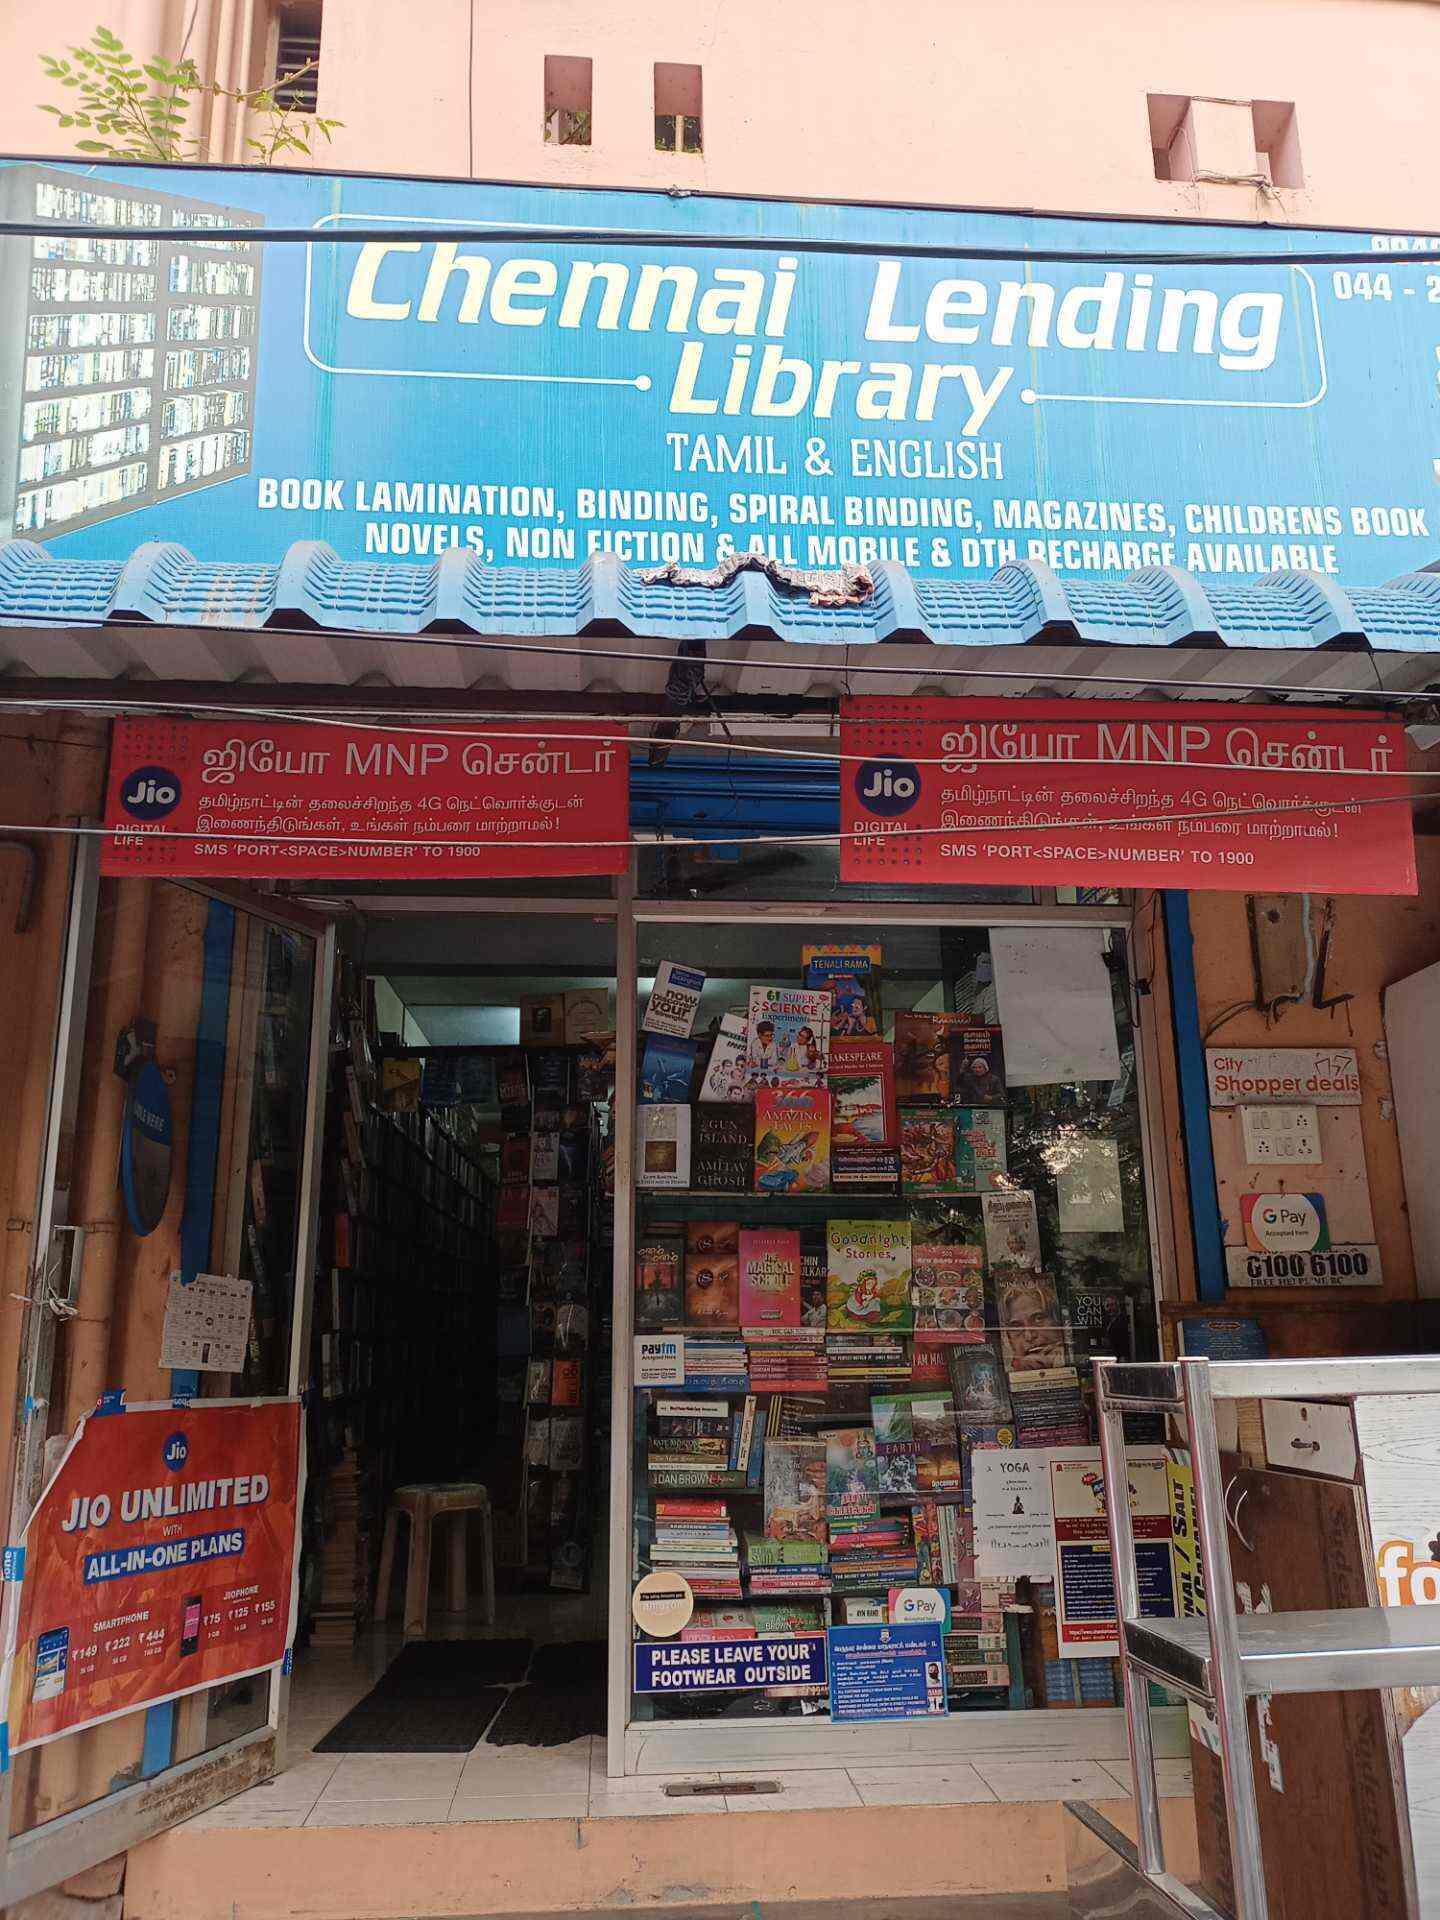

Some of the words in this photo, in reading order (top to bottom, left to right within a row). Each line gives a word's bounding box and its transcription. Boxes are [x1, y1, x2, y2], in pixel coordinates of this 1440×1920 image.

[1333, 271, 1392, 301] 044
[346, 241, 798, 337] Chennai
[864, 260, 1284, 371] Lending
[668, 341, 1014, 436] Library
[666, 433, 787, 474] TAMIL
[804, 437, 834, 476] &
[851, 438, 1003, 480] ENGLISH
[258, 478, 344, 511] BOOK
[355, 480, 565, 523] LAMINATION,
[577, 488, 719, 529] BINDING,
[729, 492, 835, 526] SPIRAL
[844, 496, 983, 533] BINDING,
[993, 498, 1176, 538] MAGAZINES,
[1184, 503, 1342, 535] CHILDRENS
[1350, 506, 1430, 537] BOOK
[365, 522, 493, 562] NOVELS,
[506, 527, 575, 559] NON
[587, 529, 704, 562] FICTION
[716, 532, 736, 562] &
[748, 533, 799, 565] ALL
[808, 535, 920, 567] MOBILE
[931, 537, 952, 567] &
[961, 538, 1016, 570] DTH
[1028, 539, 1175, 570] RECHARGE
[1187, 542, 1339, 575] AVAILABLE
[941, 724, 1080, 774] ஜியோ
[1097, 723, 1211, 764] MNP
[1225, 727, 1392, 774] சென்டர்
[202, 738, 330, 784] ஜியோ
[345, 742, 449, 776] MNP
[461, 741, 616, 776] சென்டர்
[127, 778, 176, 805] Jio
[863, 769, 915, 798] Jio
[199, 793, 303, 812] தமிழ்நாட்டின்
[417, 796, 442, 810] 4G
[446, 794, 585, 813] நெட்வொர்க்குடன்
[940, 784, 1055, 806] தமிழ்நாட்டின்
[1180, 790, 1208, 807] 4G
[115, 823, 168, 835] DIGITAL
[196, 814, 345, 833] இணைந்திடுங்கள்,
[350, 817, 407, 833] உங்கள்
[413, 817, 470, 836] நம்பரை
[853, 821, 908, 834] DIGITAL
[114, 835, 144, 846] LIFE
[854, 834, 886, 846] LIFE
[194, 843, 228, 856] SMS
[422, 846, 443, 857] TO
[447, 846, 481, 857] 1900
[940, 843, 977, 857] SMS
[1190, 850, 1212, 863] TO
[1217, 851, 1254, 864] 1900
[783, 992, 815, 1004] SUPER
[762, 1001, 818, 1014] SCIENCE
[1214, 1057, 1244, 1073] City
[1214, 1075, 1301, 1098] Shopper
[1306, 1075, 1360, 1092] deals
[762, 1109, 822, 1121] AMAZING
[699, 1133, 747, 1144] ISLAND
[697, 1175, 745, 1186] GHOSH
[1263, 1209, 1277, 1223] G
[1280, 1209, 1307, 1226] Pay
[831, 1232, 906, 1249] Goodnight
[747, 1261, 794, 1273] MAGICAL
[1310, 1253, 1368, 1277] 6100
[1076, 1296, 1101, 1306] YOU
[1077, 1306, 1102, 1315] CAN
[1077, 1316, 1102, 1326] WIN
[166, 1440, 187, 1461] Jio
[886, 1443, 921, 1453] EARTH
[1000, 1462, 1030, 1472] YOGA
[658, 1474, 677, 1485] DAN
[61, 1493, 111, 1532] JIO
[120, 1473, 270, 1522] UNLIMITED
[162, 1524, 183, 1537] WITH
[87, 1543, 189, 1580] ALL-IN-ONE
[190, 1532, 243, 1563] PLANS
[904, 1599, 914, 1611] G
[917, 1600, 936, 1614] Pay
[92, 1610, 150, 1633] SMARTPHONE
[651, 1647, 710, 1666] PLEASE
[714, 1645, 764, 1664] LEAVE
[766, 1643, 810, 1662] YOUR
[651, 1668, 737, 1688] FOOTWEAR
[744, 1663, 811, 1682] OUTSIDE
